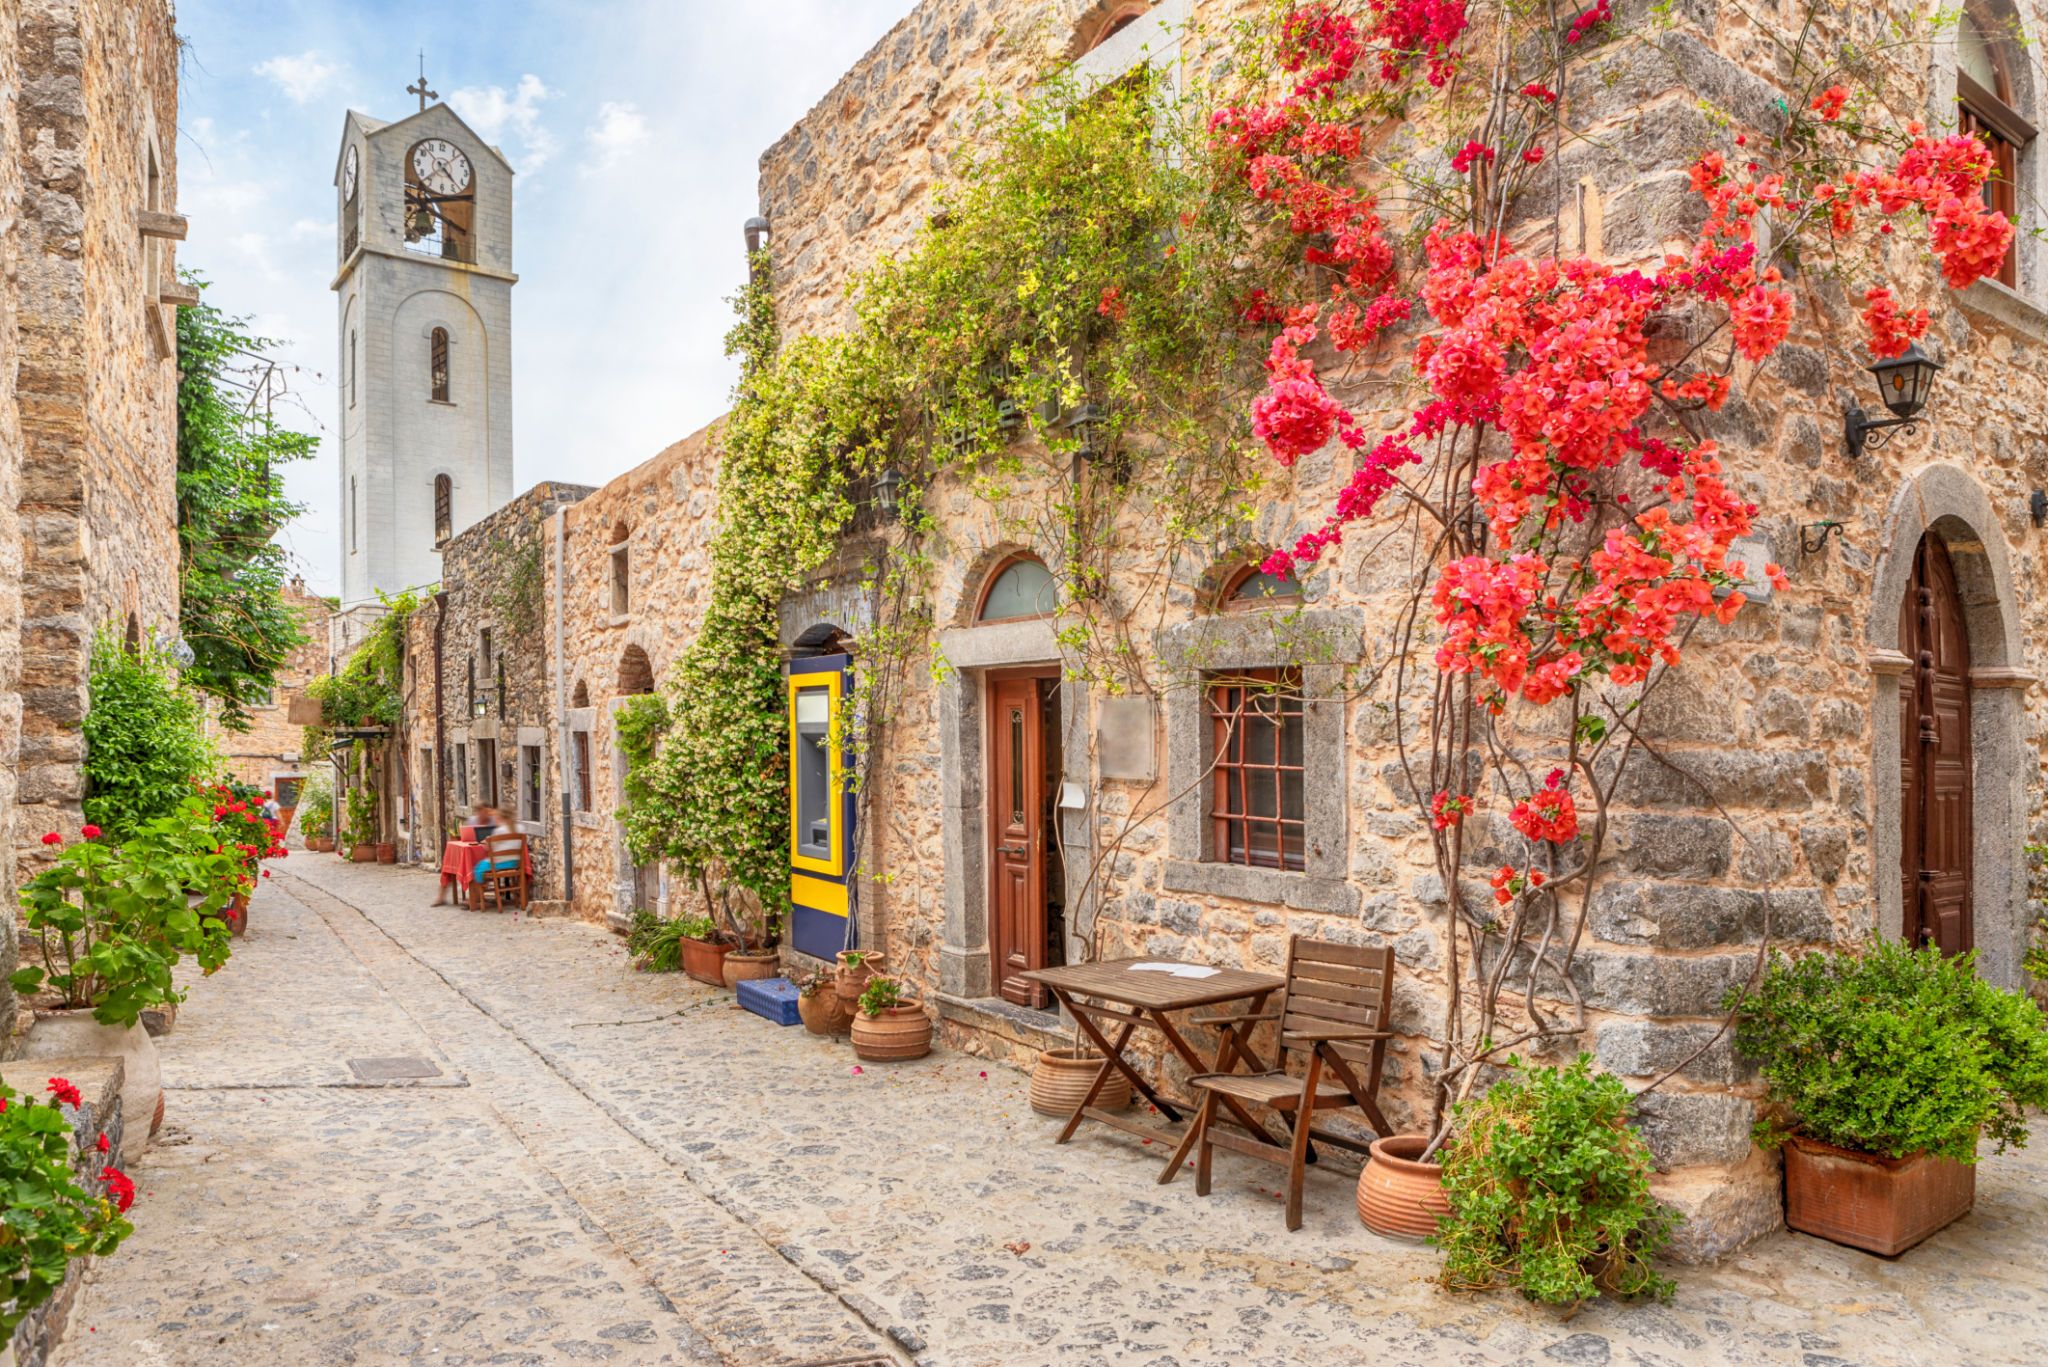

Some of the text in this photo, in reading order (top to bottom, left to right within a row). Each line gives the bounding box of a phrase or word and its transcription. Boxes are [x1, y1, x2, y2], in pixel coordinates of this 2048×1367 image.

[428, 144, 434, 152] 11
[439, 143, 446, 152] 12
[420, 149, 427, 157] 10
[460, 159, 465, 168] 2
[463, 169, 468, 178] 3
[440, 183, 445, 192] 6
